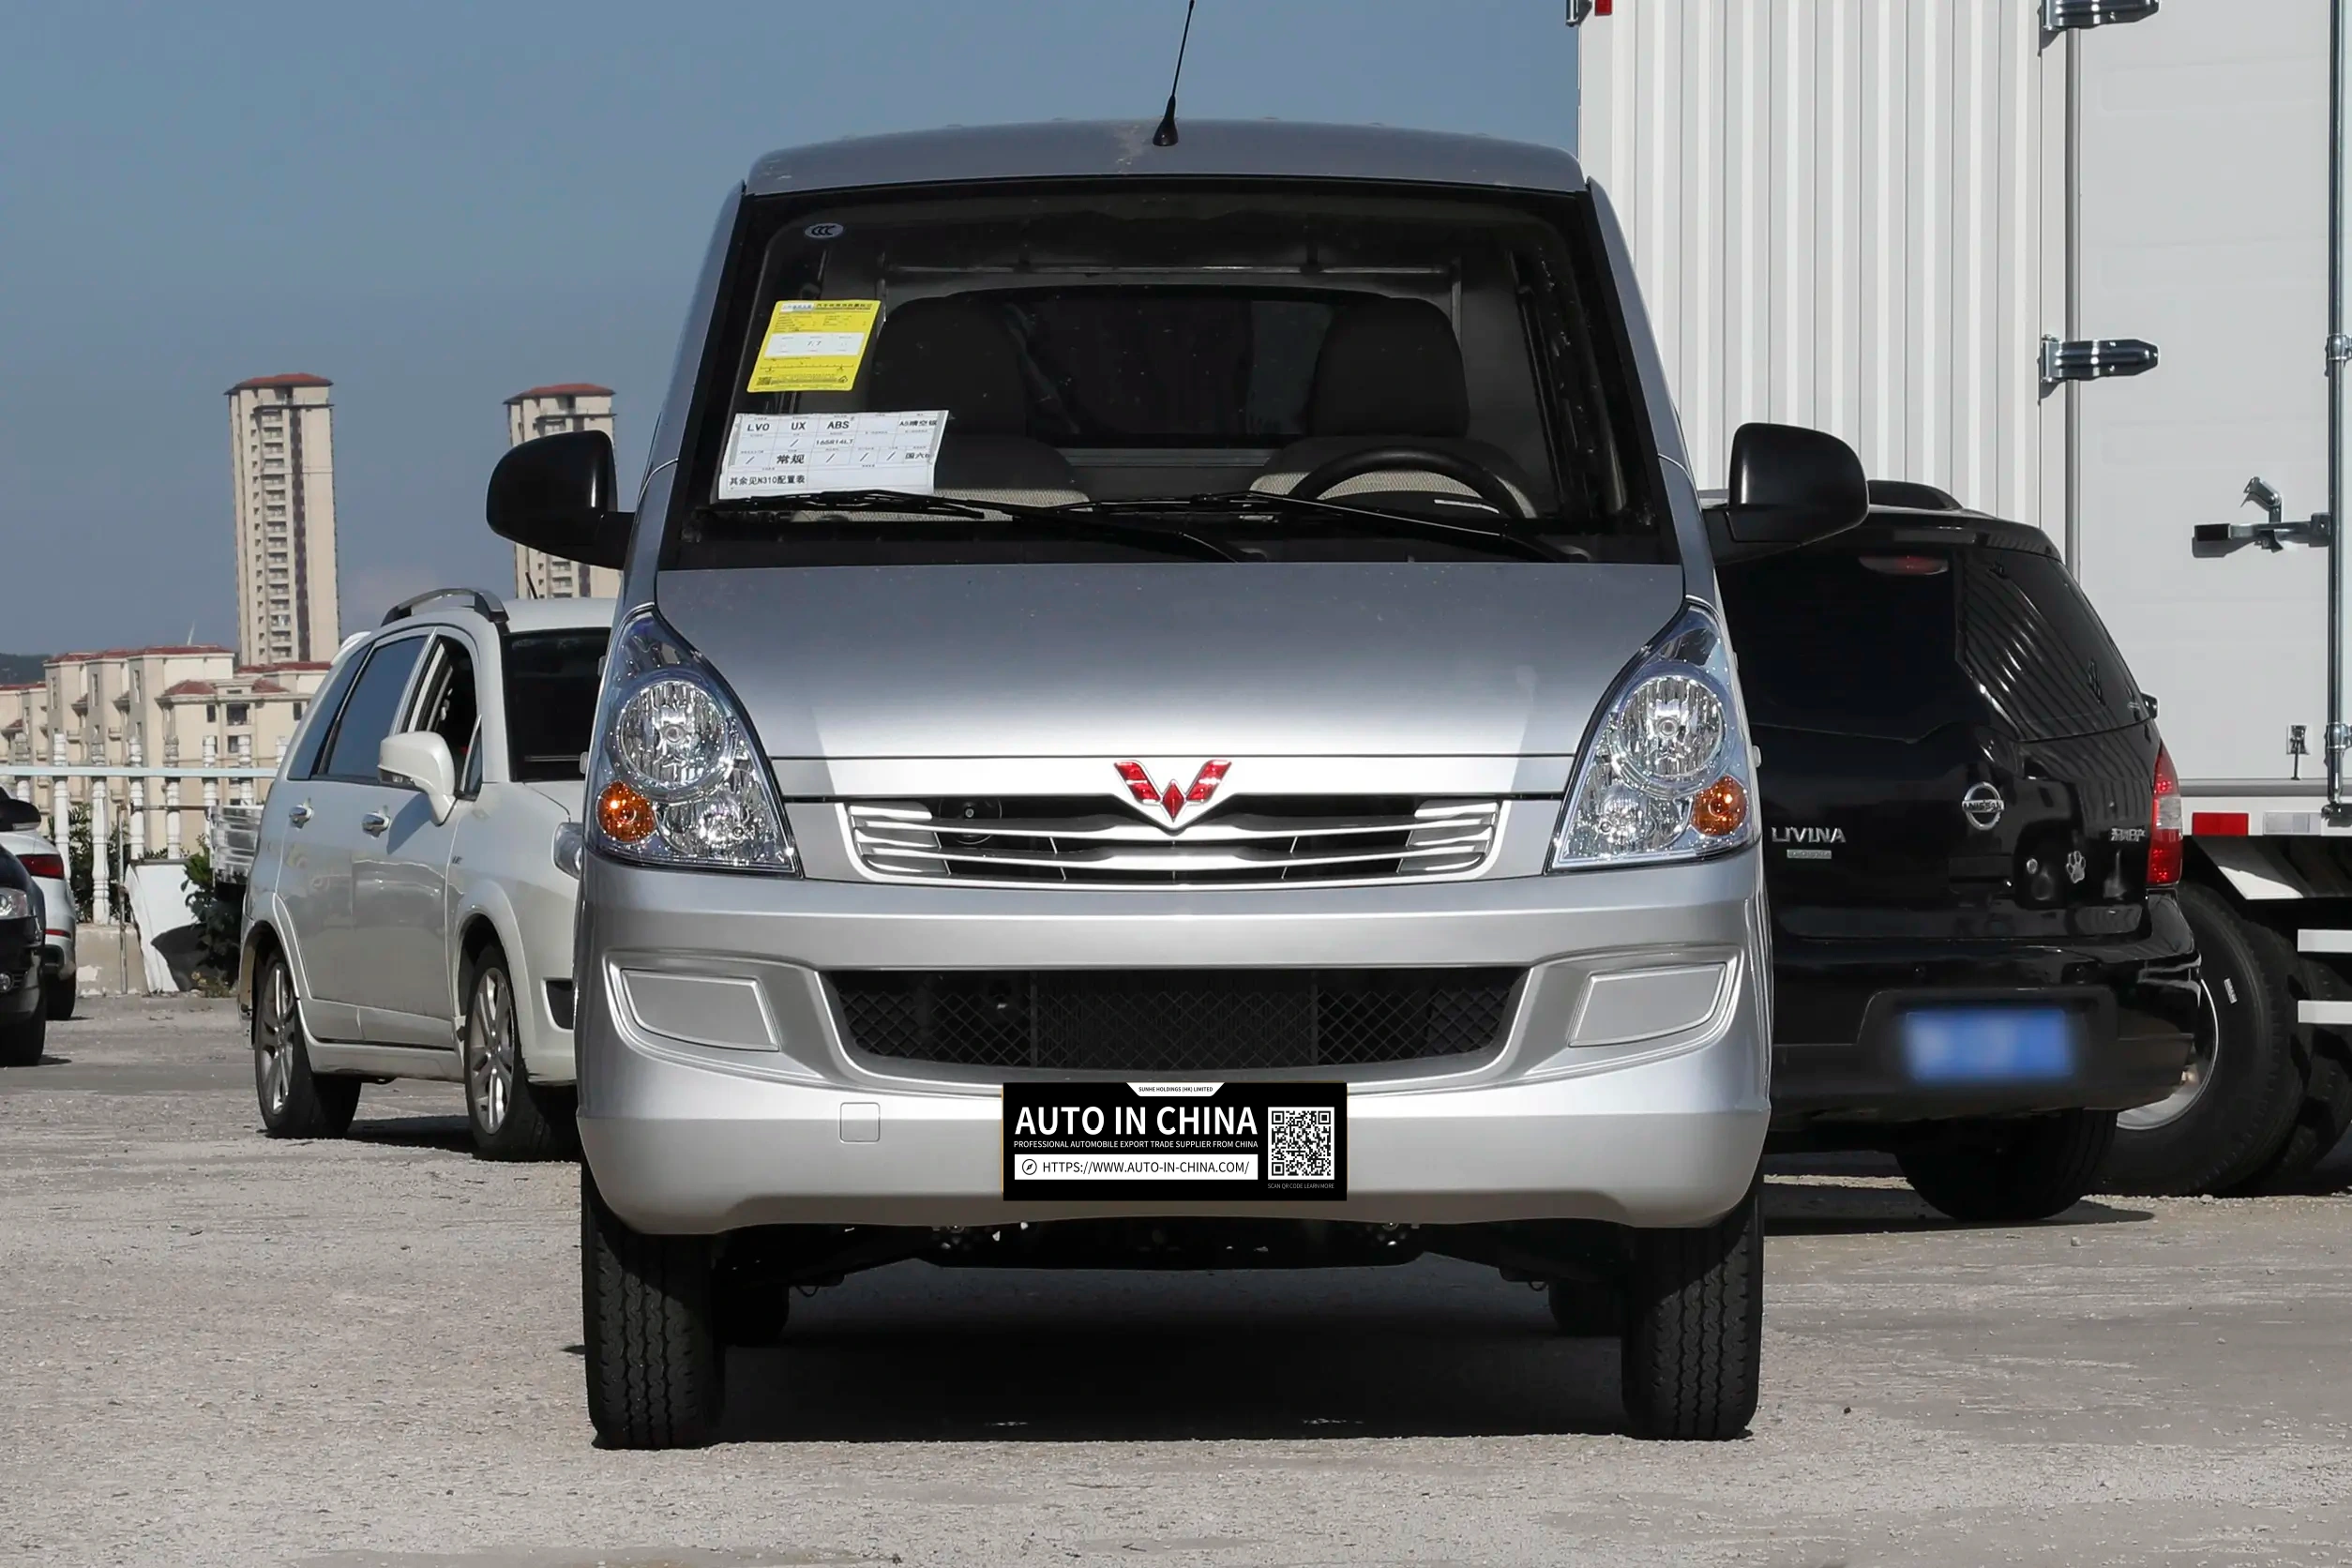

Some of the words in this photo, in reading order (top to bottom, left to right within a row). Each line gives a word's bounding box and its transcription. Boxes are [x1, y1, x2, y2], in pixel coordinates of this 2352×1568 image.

[791, 421, 807, 430] UX
[826, 420, 850, 430] ABS
[776, 454, 805, 465] 常规
[1772, 827, 1847, 843] LIVINA
